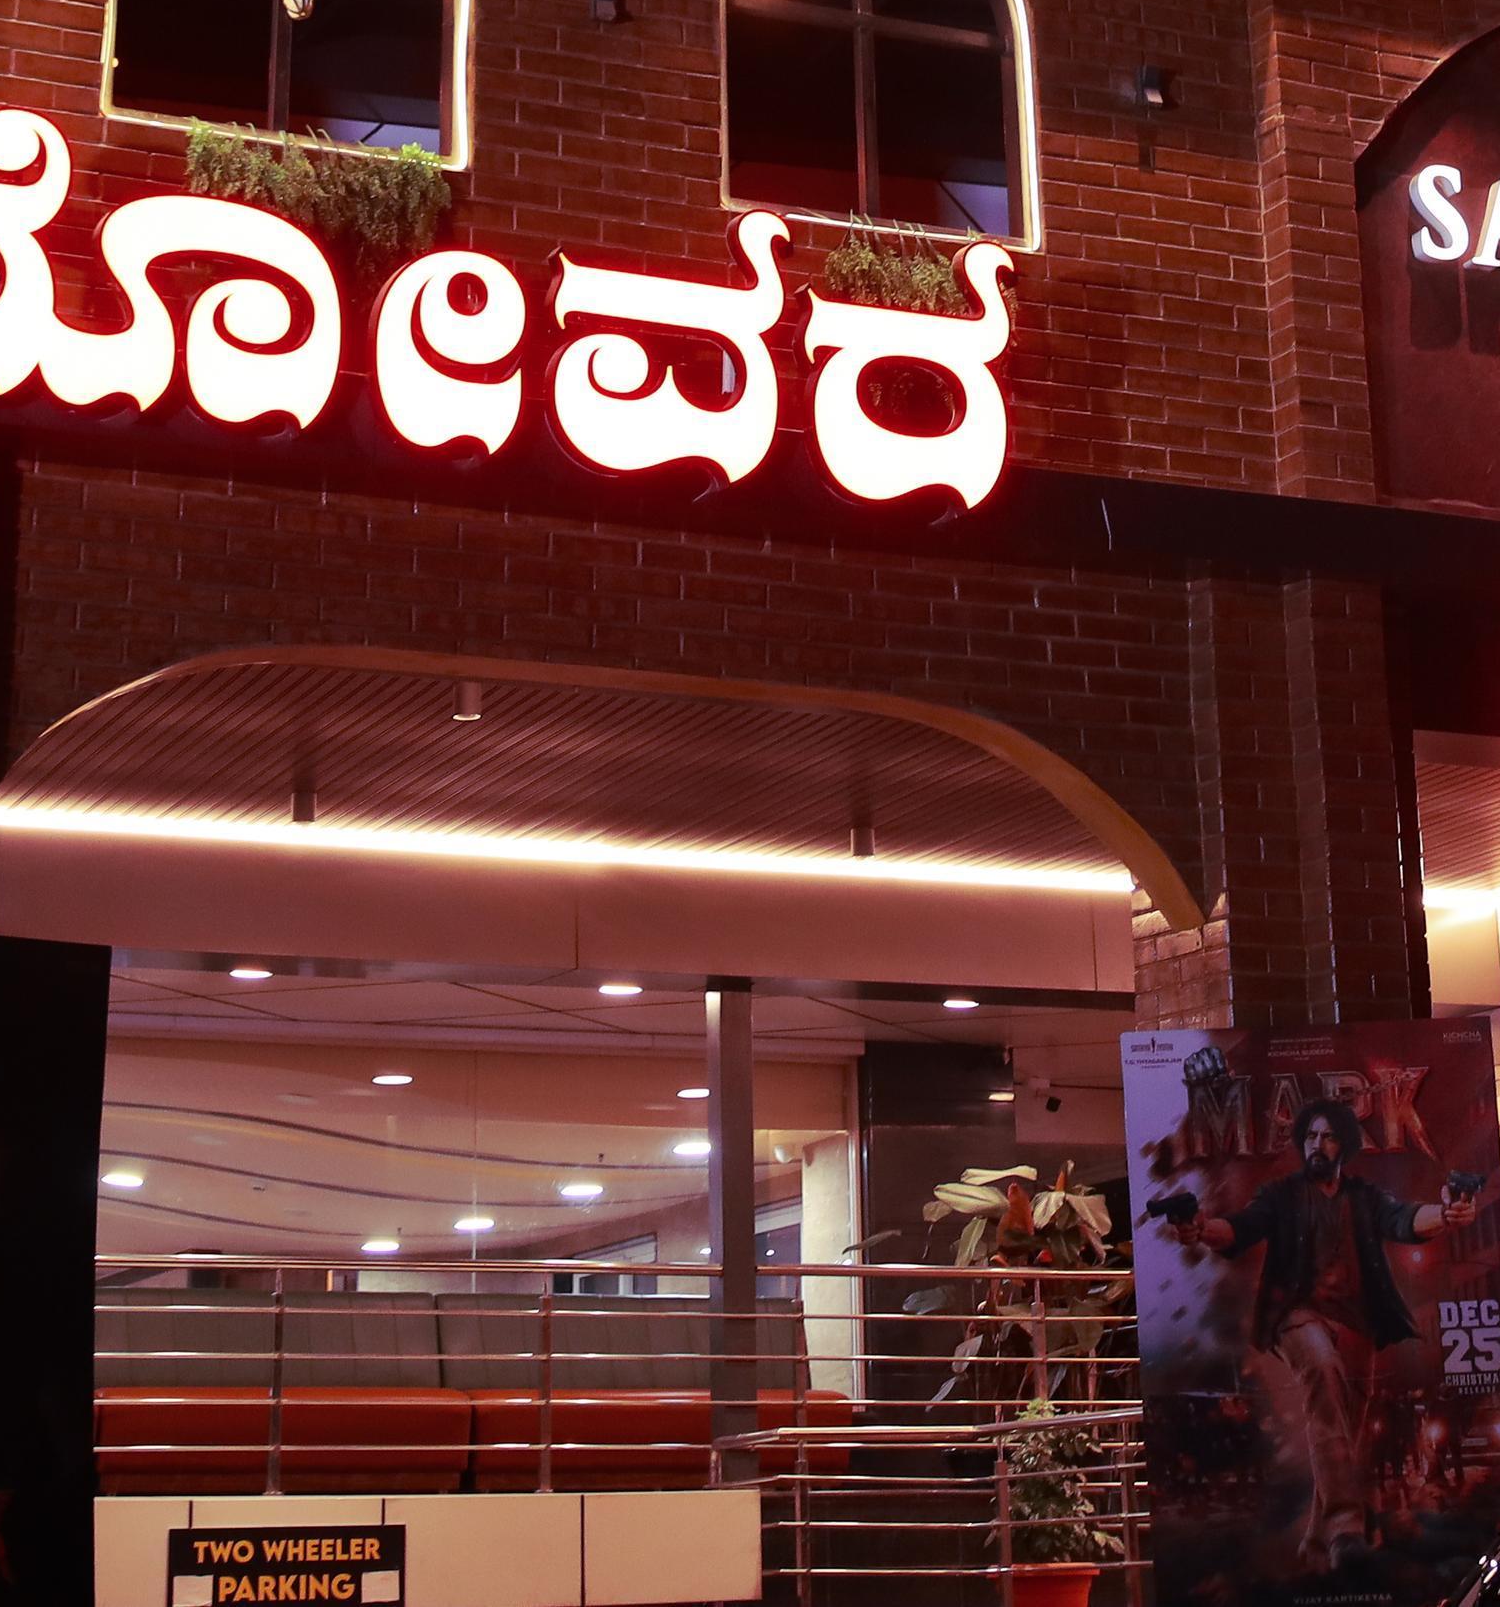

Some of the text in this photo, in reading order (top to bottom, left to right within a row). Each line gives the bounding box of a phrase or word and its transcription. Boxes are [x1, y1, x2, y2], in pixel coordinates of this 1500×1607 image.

[1182, 1065, 1438, 1161] MARK
[1438, 1299, 1500, 1329] DEC
[193, 1538, 381, 1564] TWO WHEELER
[218, 1573, 356, 1603] PARKING
